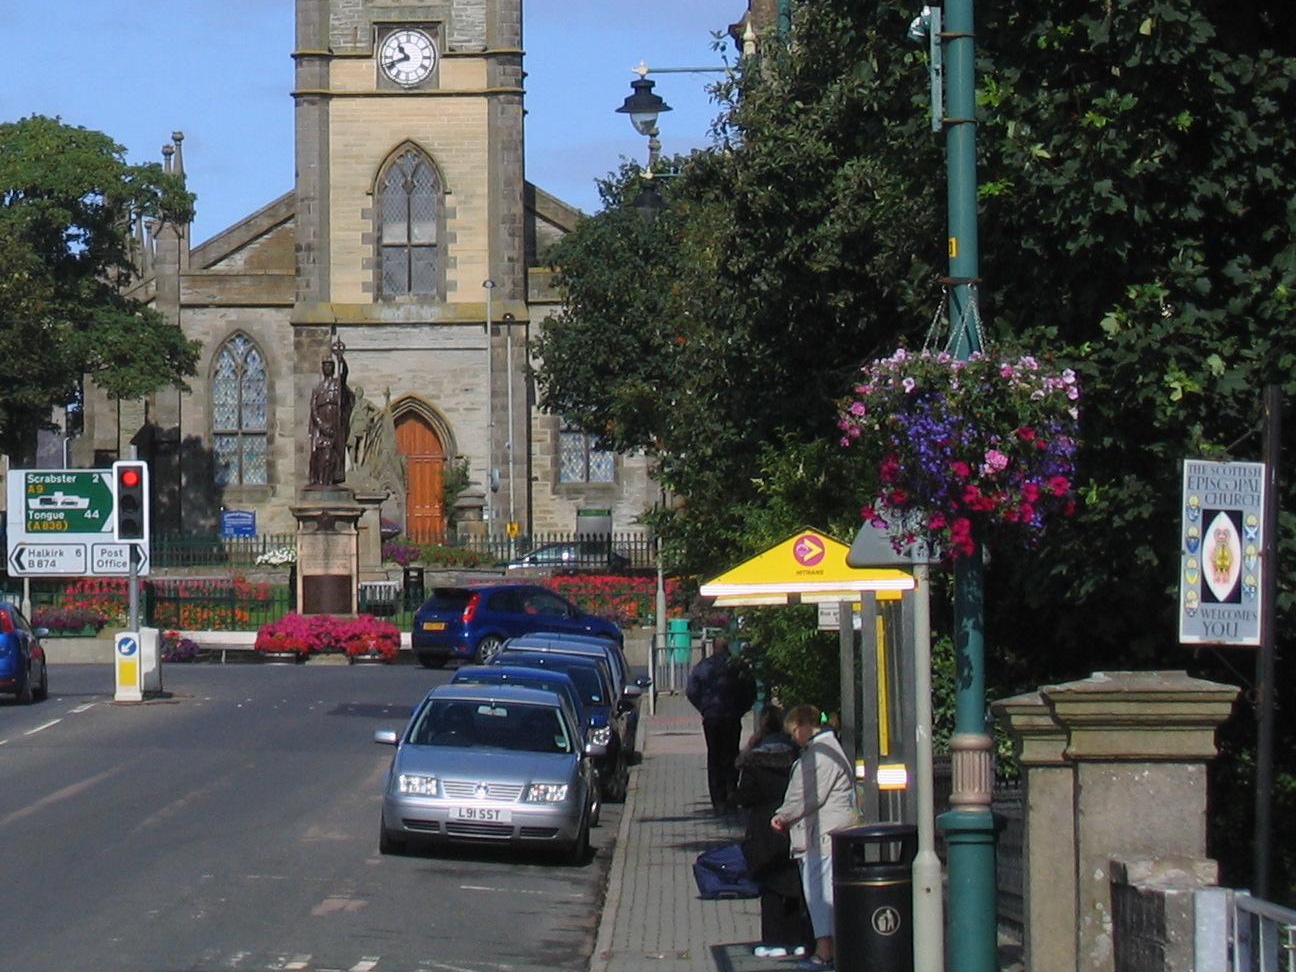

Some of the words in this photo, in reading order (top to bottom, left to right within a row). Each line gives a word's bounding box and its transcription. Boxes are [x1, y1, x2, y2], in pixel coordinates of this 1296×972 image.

[1189, 465, 1206, 474] THE
[1210, 466, 1262, 477] SCOTTISH
[27, 474, 77, 484] Scrabster
[92, 474, 99, 483] 2
[1188, 476, 1261, 492] EPISCOPAL
[1205, 493, 1261, 506] CHURCH
[27, 510, 65, 521] Tongue
[84, 510, 100, 519] 44
[28, 549, 64, 558] Halkirk
[75, 549, 82, 558] 6
[101, 549, 123, 558] Post
[96, 559, 128, 569] Office
[1201, 608, 1258, 621] WELCOMES
[1203, 621, 1238, 637] YOU
[479, 809, 501, 821] SST
